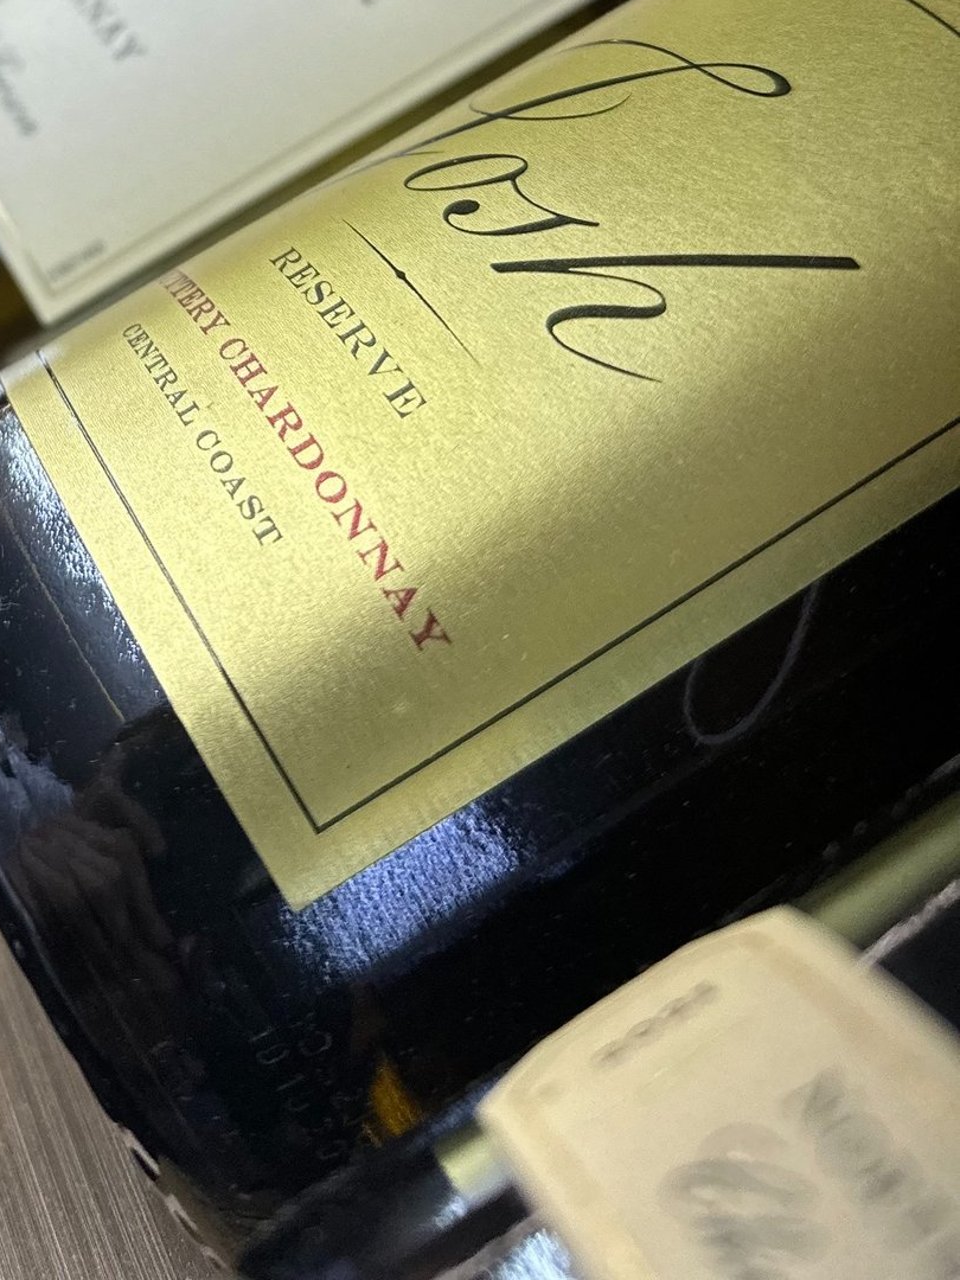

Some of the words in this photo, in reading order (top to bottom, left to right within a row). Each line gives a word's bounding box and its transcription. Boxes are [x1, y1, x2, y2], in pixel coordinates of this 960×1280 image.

[121, 322, 200, 426] CENTRAL
[196, 428, 285, 550] COAST
[268, 246, 429, 421] RESERVE
[218, 337, 453, 654] CHARDONNAY
